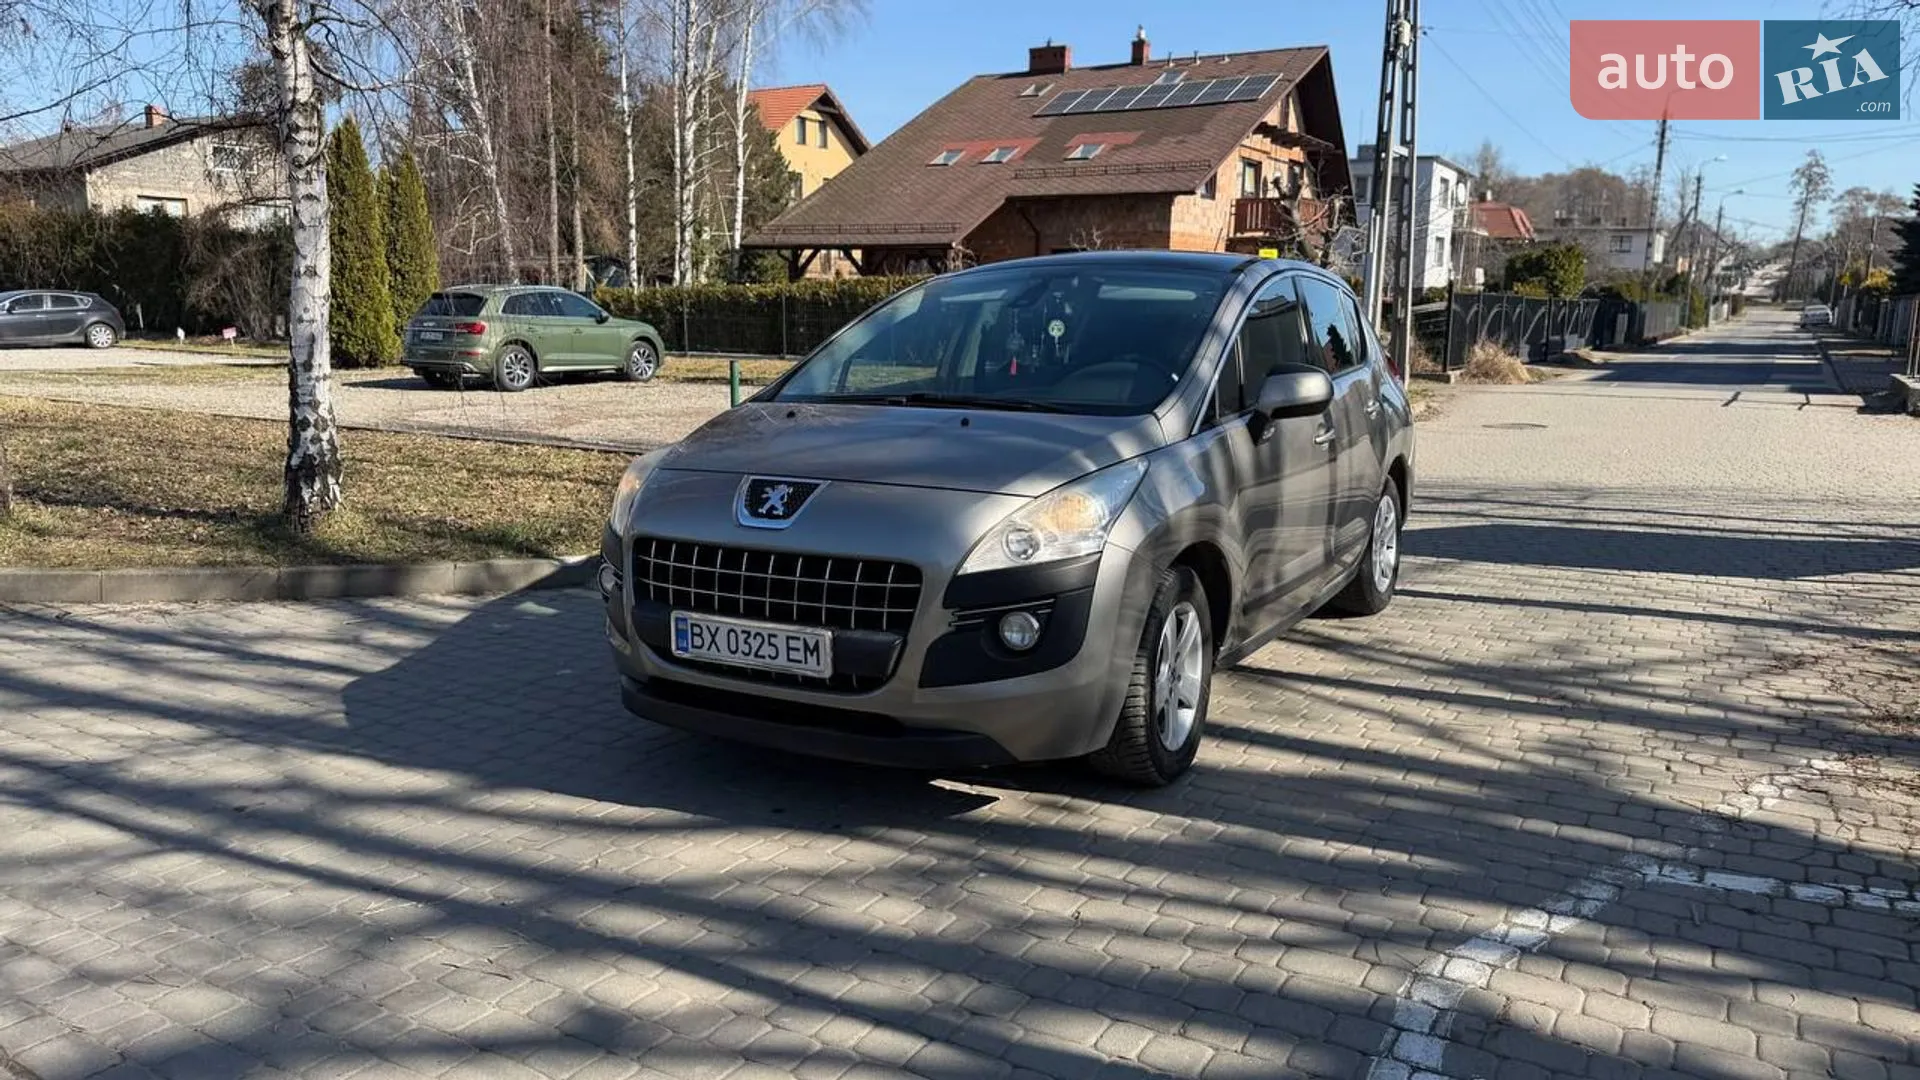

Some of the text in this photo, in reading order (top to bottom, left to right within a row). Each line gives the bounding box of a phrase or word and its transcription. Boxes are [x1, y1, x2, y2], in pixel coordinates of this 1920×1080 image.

[690, 623, 821, 666] BX 0325 EM
